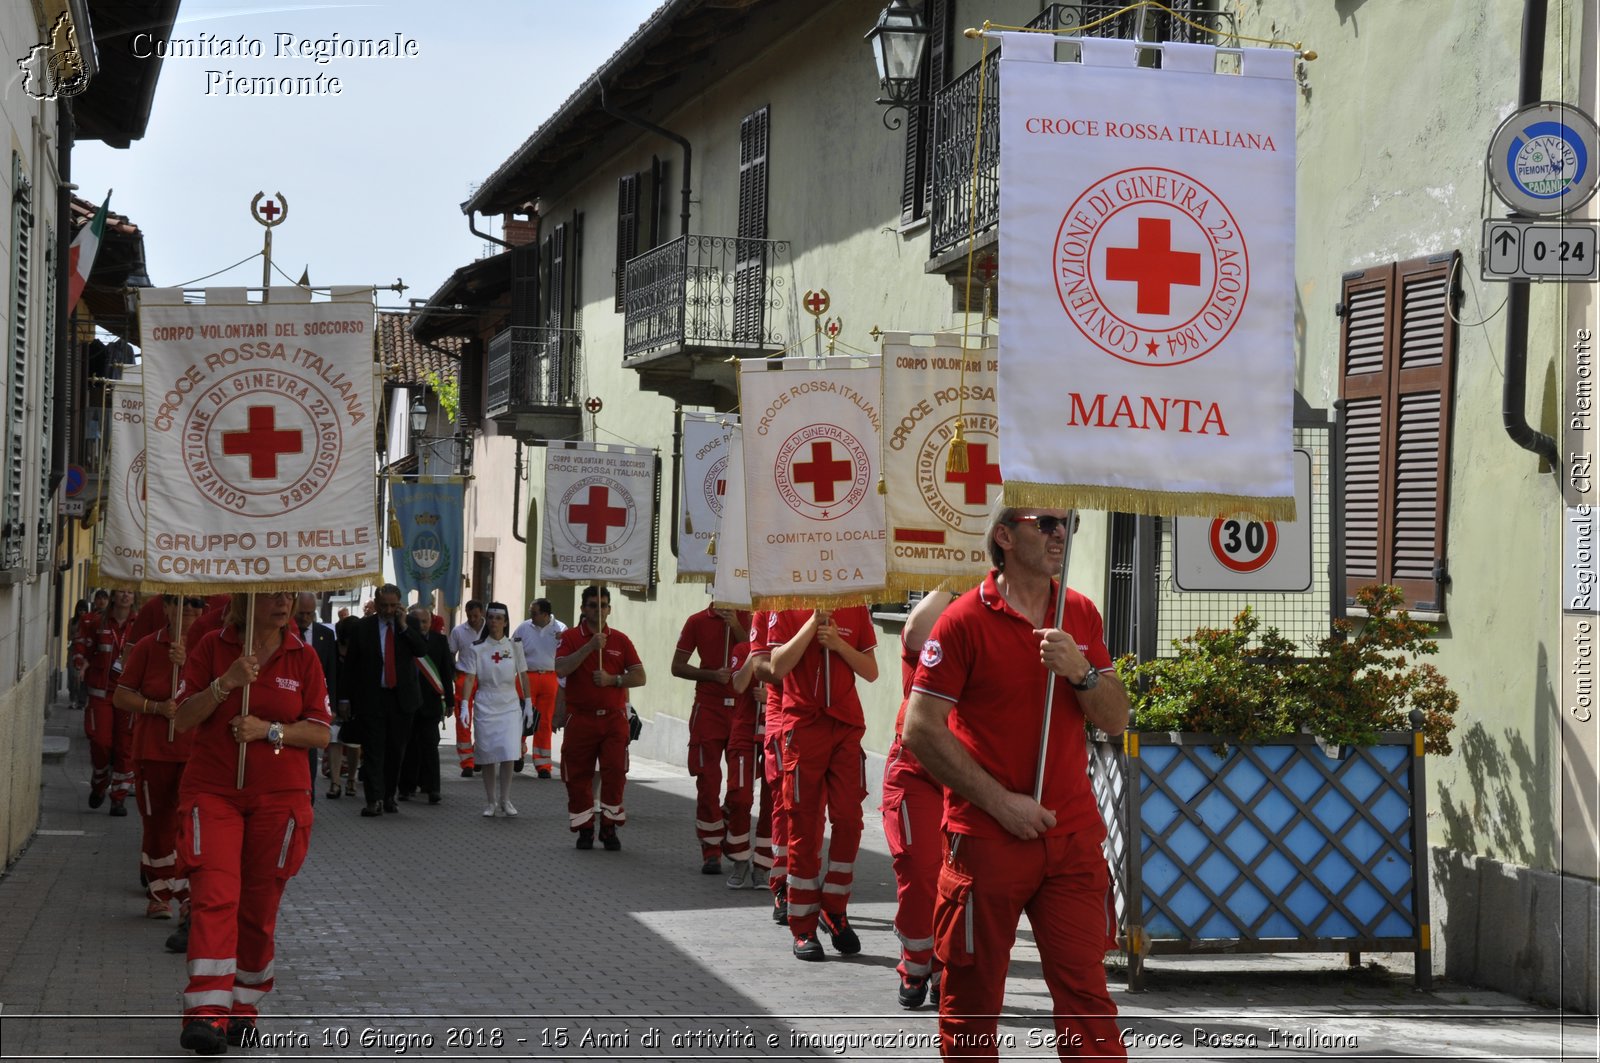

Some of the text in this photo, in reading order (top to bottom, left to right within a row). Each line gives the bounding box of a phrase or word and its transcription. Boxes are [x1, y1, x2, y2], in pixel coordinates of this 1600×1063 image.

[1025, 117, 1277, 152] CROCE ROSSA ITALIANA
[1518, 138, 1575, 166] LEGA NORD
[1062, 175, 1242, 357] CONVENZIONE DI GINEVRA 22 AGOSTO 1864
[153, 321, 364, 341] CORPO VOLONTARI DEL SOCCORSO
[896, 356, 927, 370] CORPO
[154, 341, 367, 433] CROCE ROSSA ITALIANA
[208, 390, 228, 406] DI
[233, 373, 310, 401] GINEVRA
[308, 399, 330, 419] 22
[757, 381, 882, 437] CROCE ROSSA ITALIANA
[889, 385, 996, 451] CROCE ROSSA
[1066, 392, 1230, 437] MANTA
[938, 424, 952, 440] DI
[187, 408, 247, 510] CONVENZIONE
[311, 421, 337, 478] AGOSTO
[696, 438, 722, 460] CROCE
[548, 463, 651, 478] CROCE ROSSA ITALIANA
[574, 456, 604, 465] VOLONTARI
[620, 460, 646, 468] SOCCORSO
[776, 443, 802, 508] CONVENZIONE
[792, 434, 802, 445] DI
[802, 427, 842, 439] GINEVRA
[842, 435, 856, 448] 22
[852, 446, 868, 486] AGOSTO
[920, 441, 961, 527] CONVENZIONE
[156, 527, 370, 551] GRUPPO DI MELLE
[766, 529, 886, 544] COMITATO LOCALE
[1223, 520, 1264, 553] 30
[157, 552, 367, 576] COMITATO LOCALE
[560, 554, 619, 565] DELEGAZIONE
[820, 550, 834, 561] DI
[894, 545, 985, 562] COMITATO DI
[561, 565, 627, 576] PEVERAGNO
[792, 568, 864, 583] BUSCA
